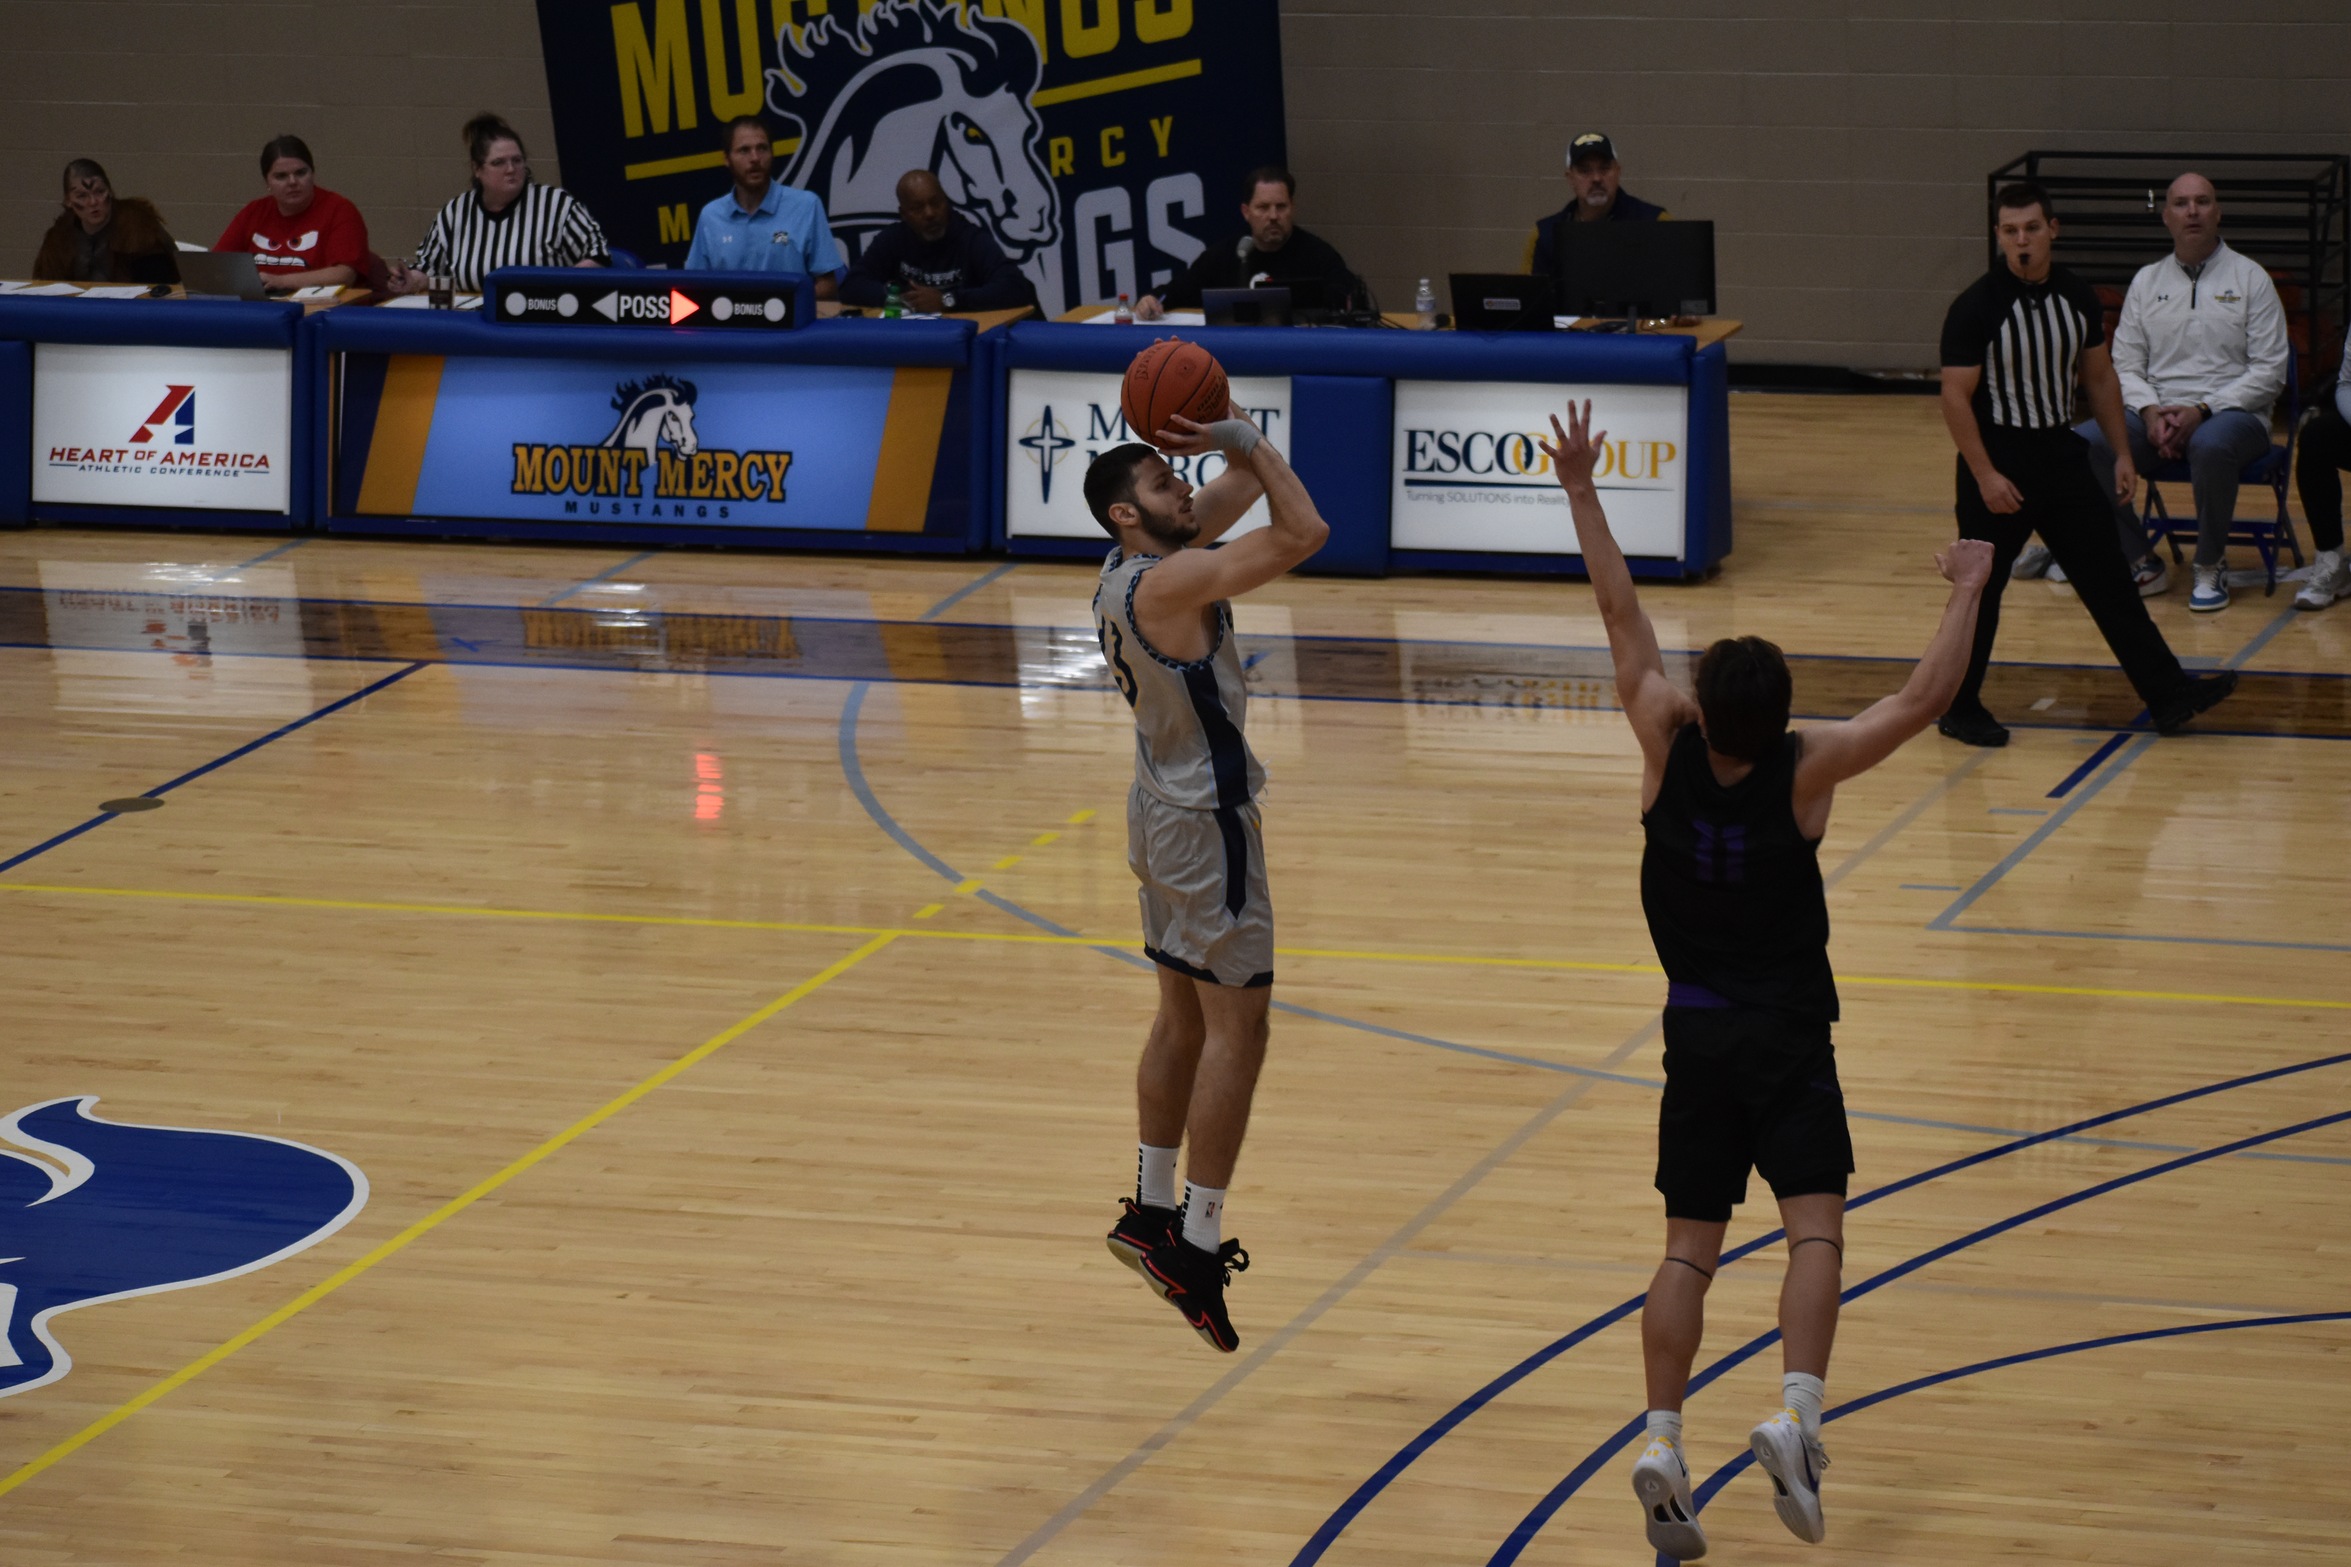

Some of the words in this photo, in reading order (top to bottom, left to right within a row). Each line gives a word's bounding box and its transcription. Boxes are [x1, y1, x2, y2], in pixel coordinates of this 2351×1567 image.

[527, 298, 557, 311] BONUS
[619, 295, 670, 320] POSS
[733, 303, 763, 316] BONUS
[49, 447, 129, 463] HEART
[134, 450, 157, 461] OF
[160, 451, 270, 468] AMERICA
[78, 464, 142, 473] ATHLETIC
[149, 467, 240, 477] CONFERENCE
[512, 444, 649, 497] MOUNT
[656, 449, 792, 502] MERCY
[1406, 491, 1445, 505] Turning
[1448, 491, 1511, 505] SOLUTIONS
[1514, 493, 1535, 505] into
[565, 501, 730, 519] MUSTANGS
[1691, 815, 1746, 882] 11
